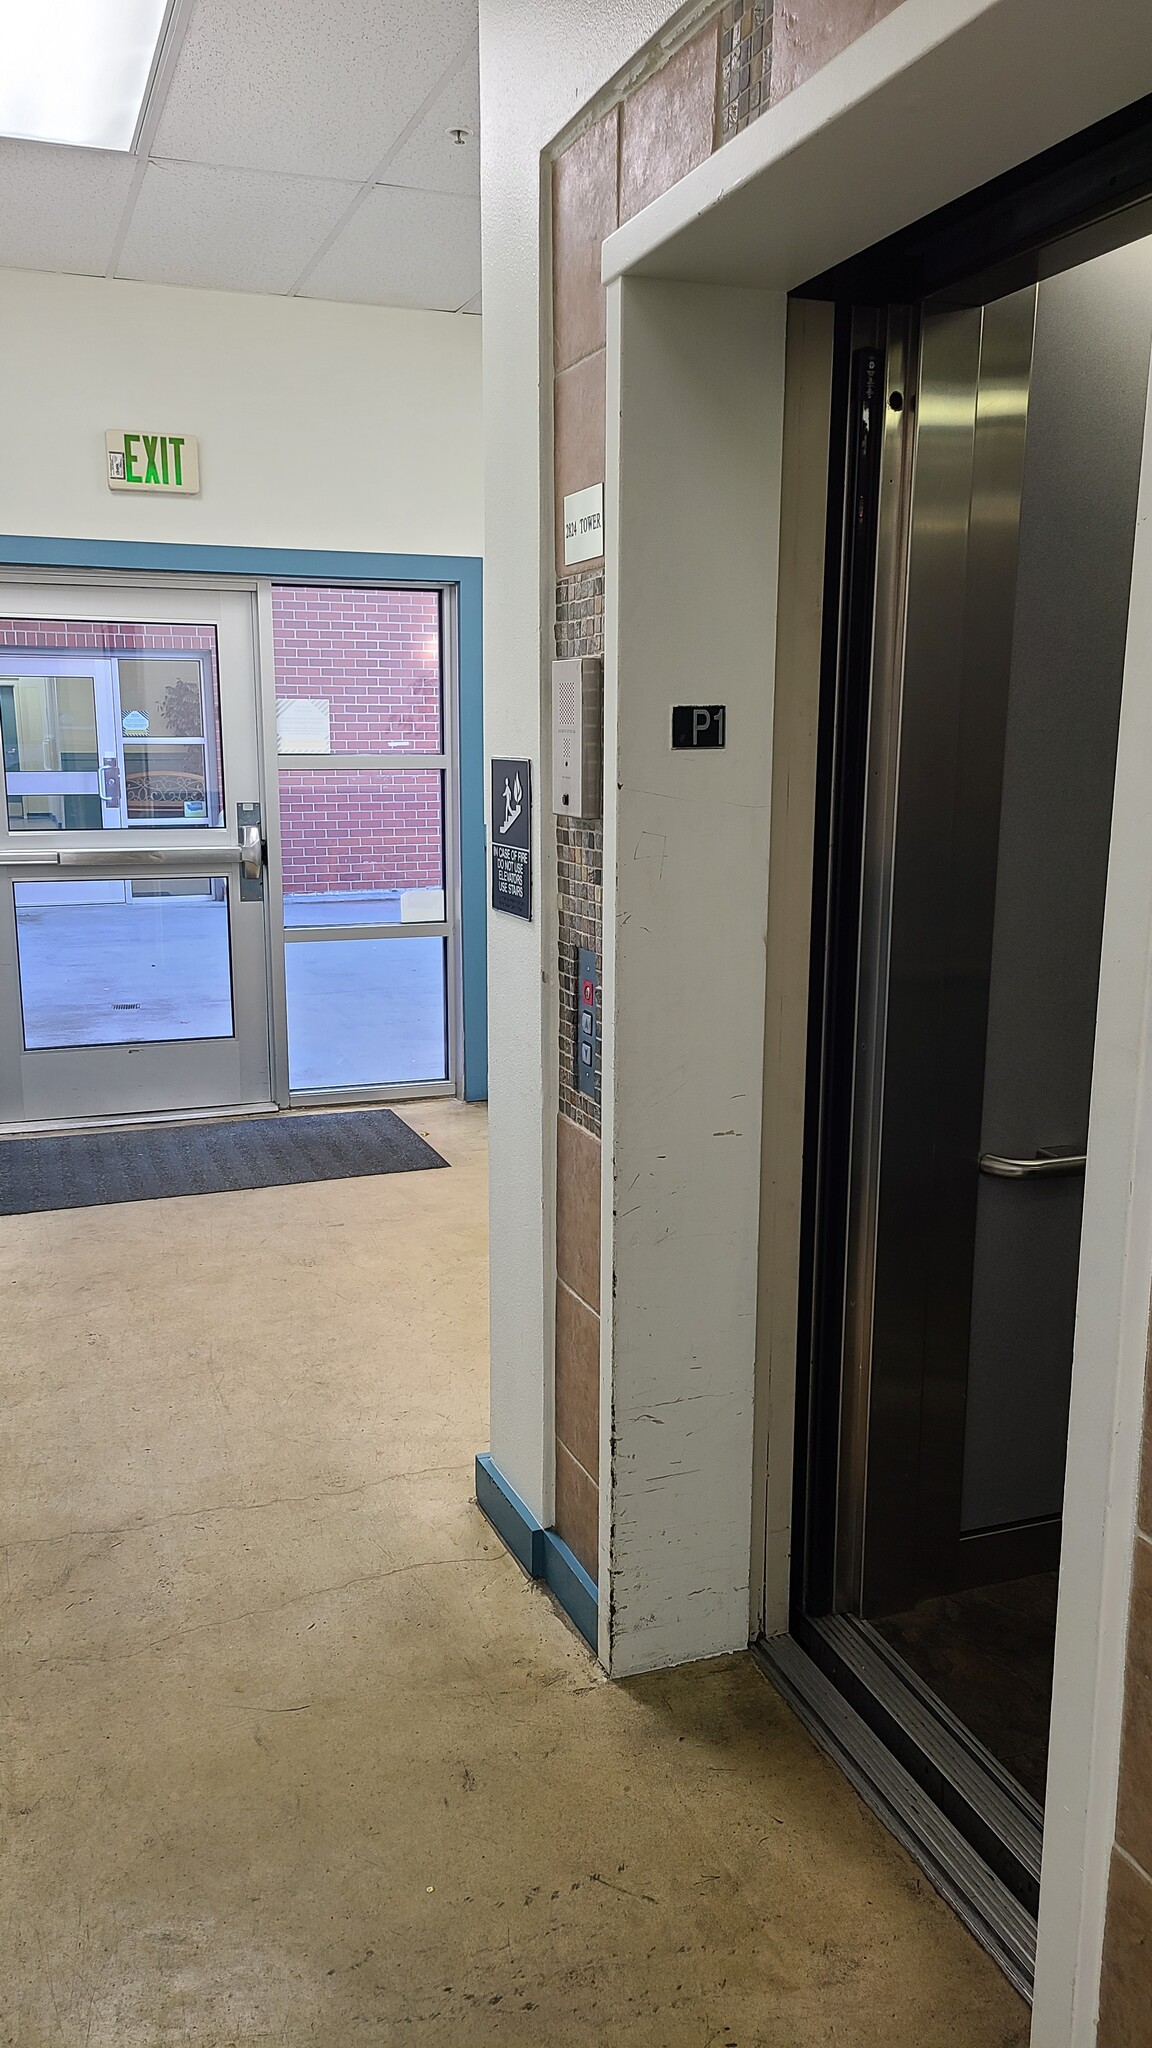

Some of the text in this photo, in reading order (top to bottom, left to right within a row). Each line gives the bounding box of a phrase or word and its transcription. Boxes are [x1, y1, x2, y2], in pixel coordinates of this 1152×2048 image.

[124, 433, 185, 486] EXIT
[579, 512, 602, 534] TOWER
[692, 708, 723, 746] P1
[493, 845, 528, 864] IN CASE OF FIRE
[497, 858, 524, 875] DO NOT USE
[498, 869, 523, 886] ELEVATORS
[498, 880, 524, 898] USE STAIRS
